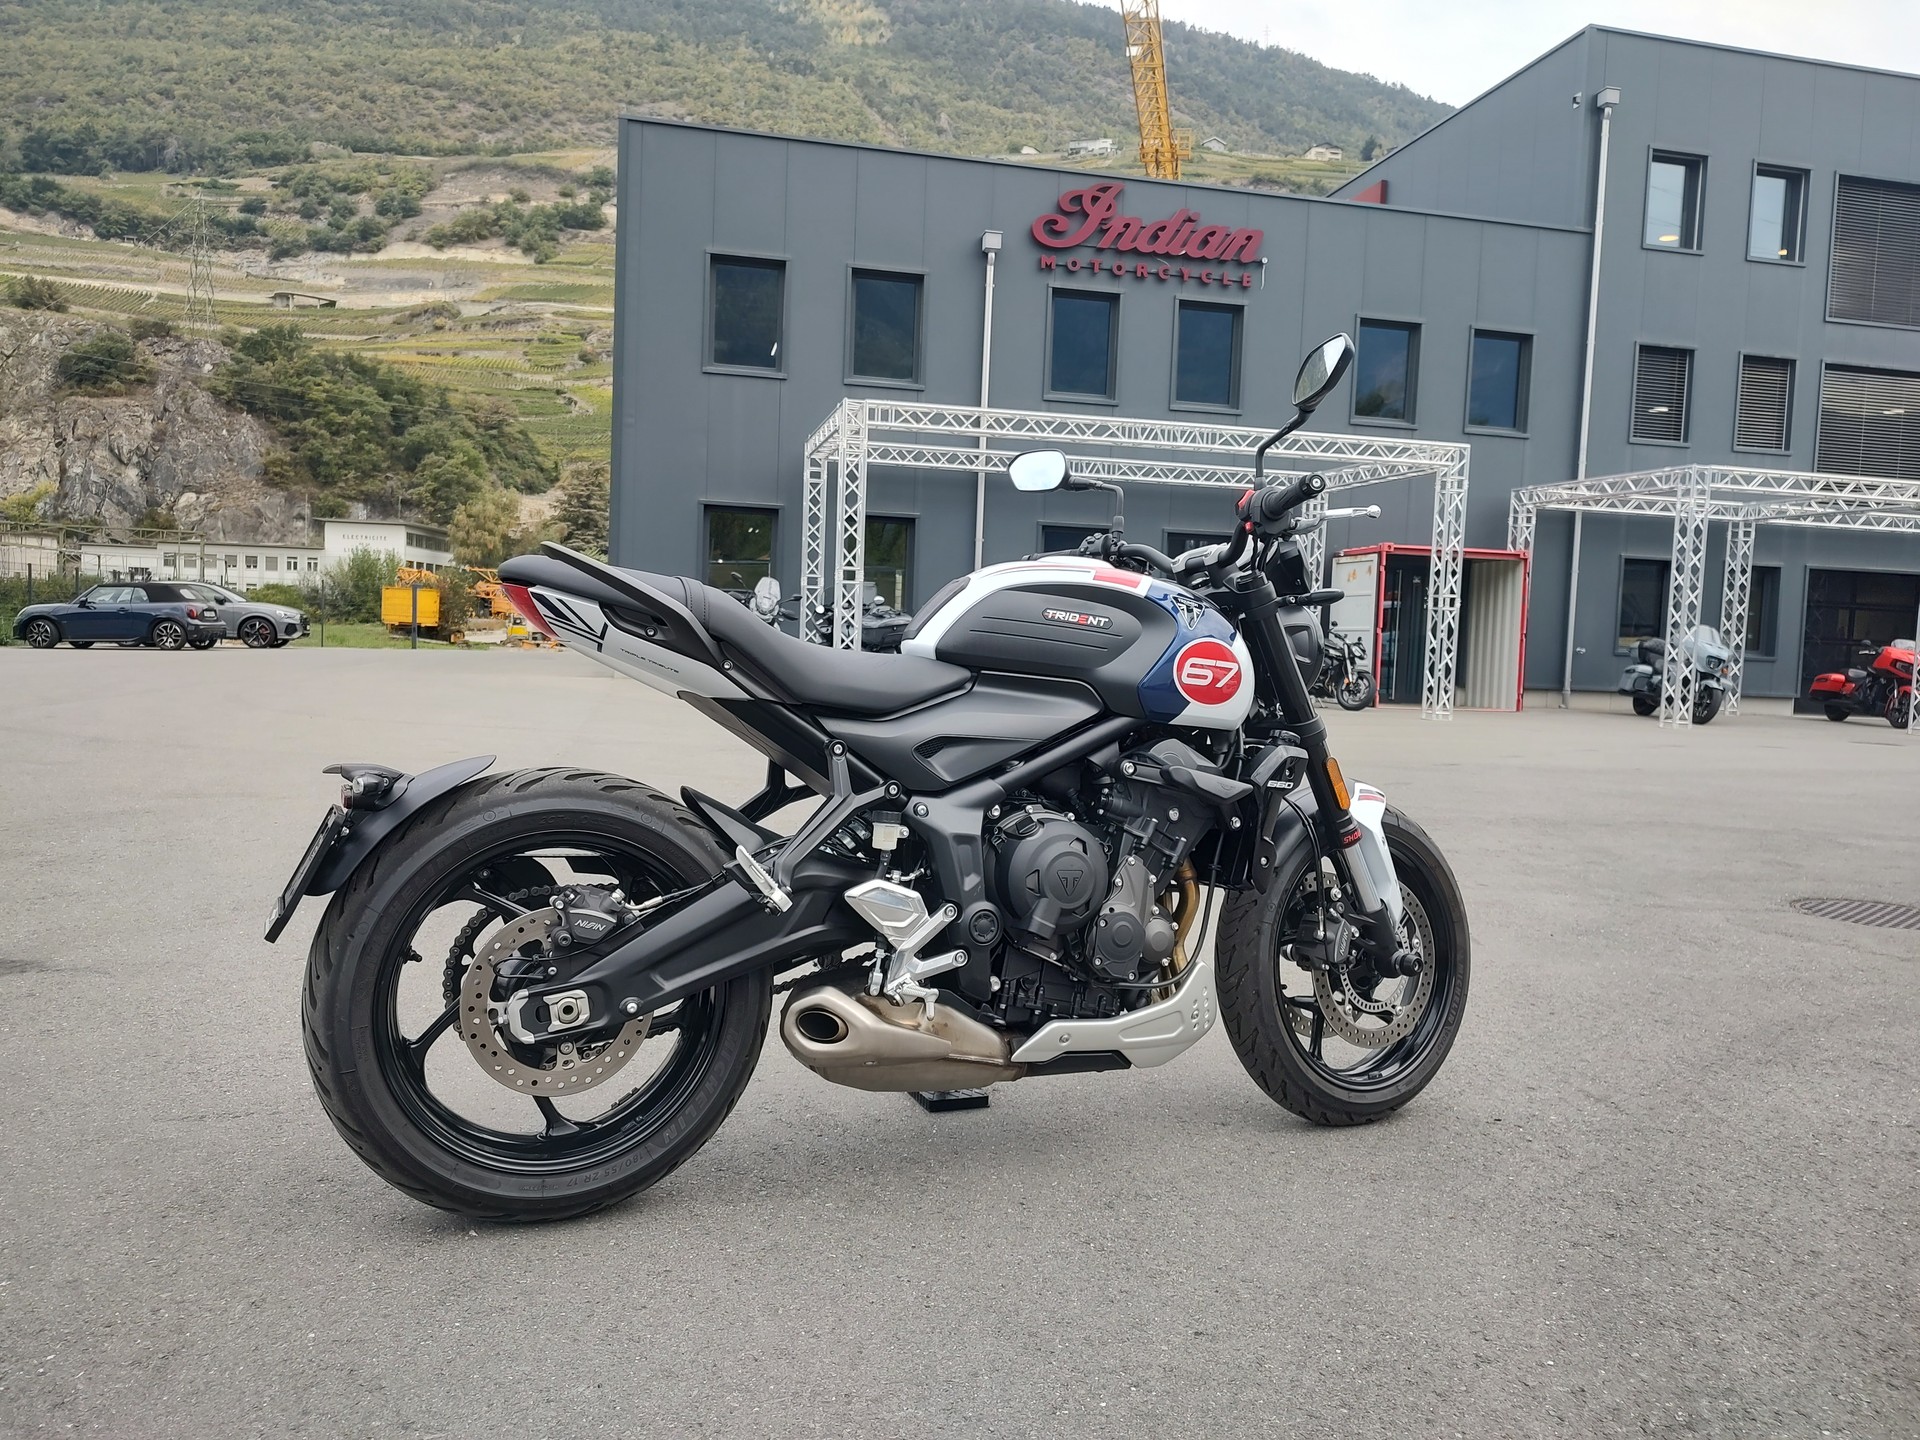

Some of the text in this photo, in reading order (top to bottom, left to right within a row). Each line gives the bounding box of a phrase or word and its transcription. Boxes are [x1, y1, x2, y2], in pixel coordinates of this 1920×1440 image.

[1031, 181, 1264, 263] Indian
[1040, 254, 1252, 288] MOTORCYCLE
[1044, 608, 1109, 627] TRIDENT
[1181, 656, 1239, 688] 67
[1267, 780, 1294, 789] 660
[662, 1026, 739, 1145] MICHELIN
